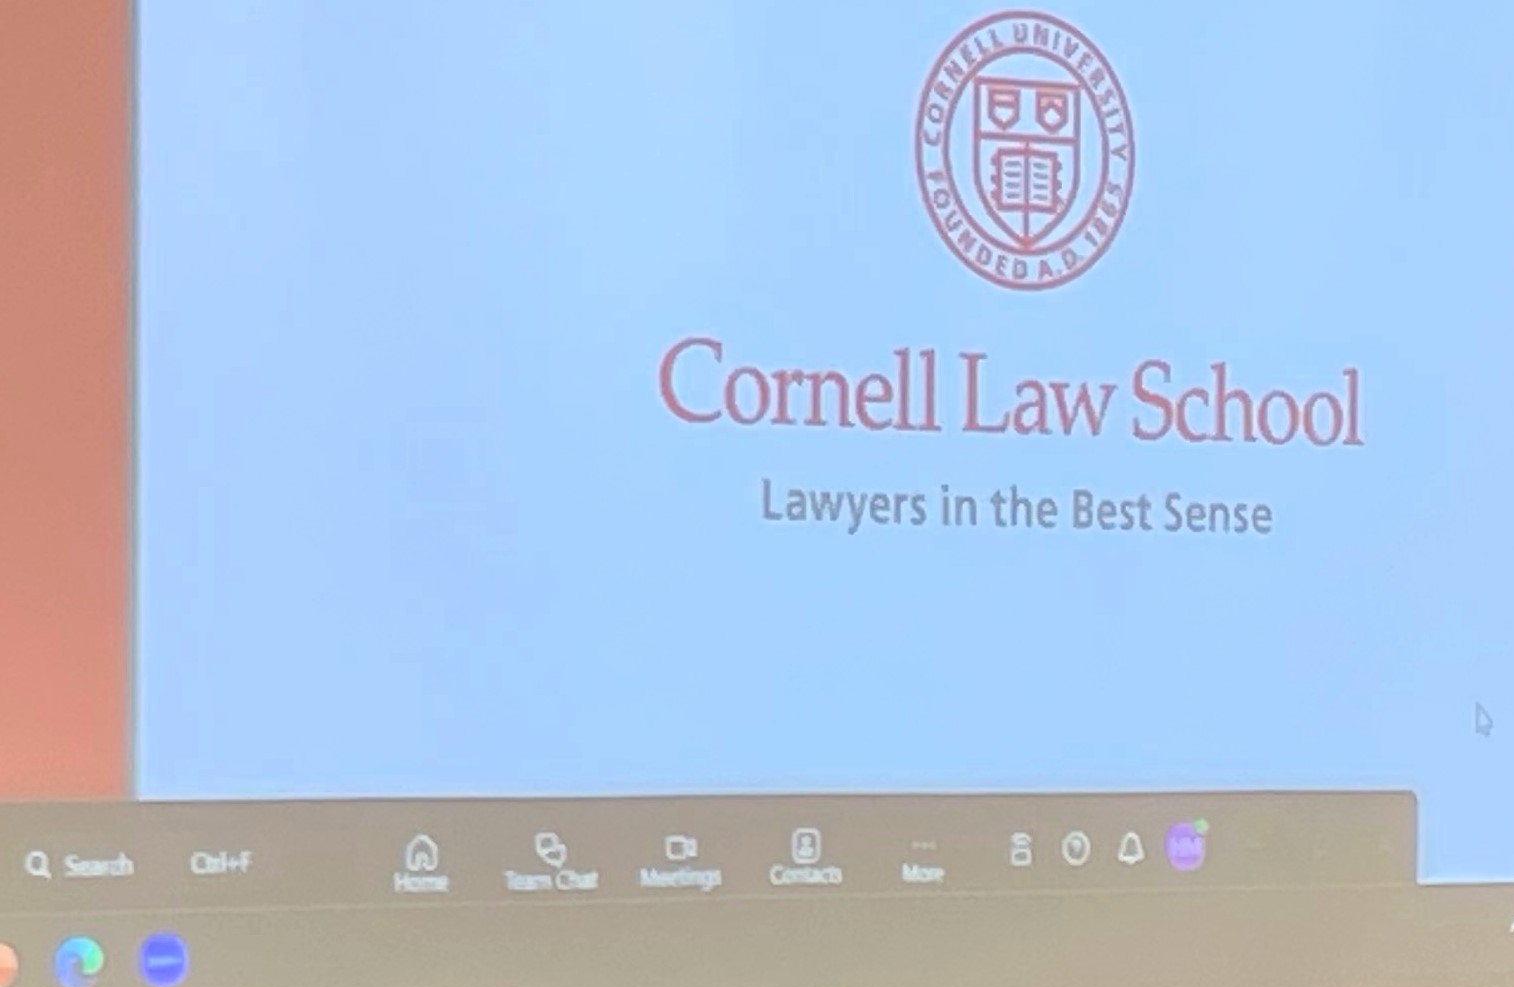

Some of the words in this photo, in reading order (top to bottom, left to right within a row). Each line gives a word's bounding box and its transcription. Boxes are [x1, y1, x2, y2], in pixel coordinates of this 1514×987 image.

[923, 26, 1005, 148] CORNELL
[1011, 21, 1128, 162] UNIVERSITY
[926, 168, 1029, 281] FOUNDED
[658, 336, 942, 433] Cornell
[958, 351, 1118, 437] Law
[1131, 358, 1366, 448] School
[761, 477, 928, 536] Lawyers
[940, 482, 979, 528] in
[989, 483, 1060, 530] the
[1072, 488, 1153, 533] Best
[1163, 490, 1274, 535] Sense
[63, 851, 135, 878] Search
[190, 850, 253, 875] Ctrl+F
[769, 864, 843, 887] Contacts
[901, 862, 946, 884] More
[393, 872, 450, 893] Home
[504, 870, 552, 892] Team
[555, 869, 599, 891] Chat
[639, 866, 722, 892] Meetings
